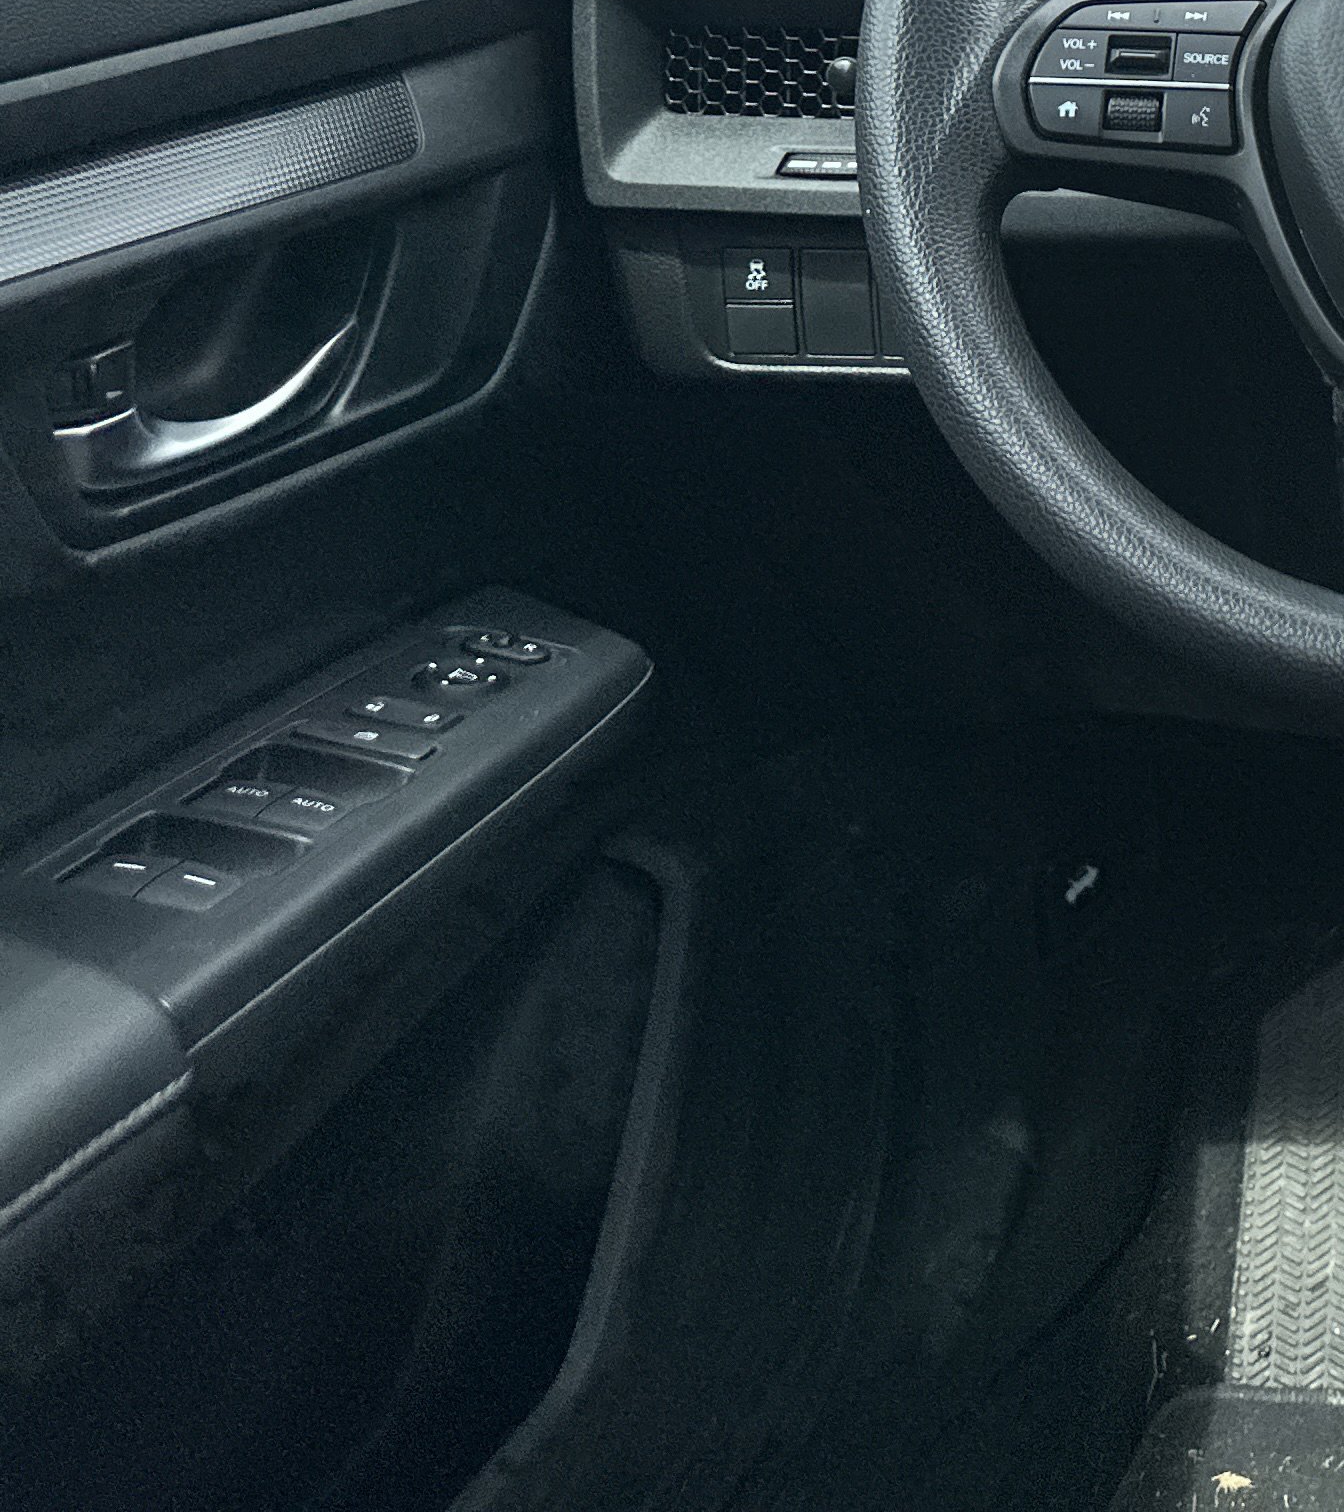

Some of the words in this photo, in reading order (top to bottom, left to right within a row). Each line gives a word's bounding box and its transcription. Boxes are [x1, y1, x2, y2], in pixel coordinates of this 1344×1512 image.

[1183, 52, 1229, 66] SOURCE
[745, 279, 769, 291] OFF
[226, 785, 269, 797] AUTO
[291, 797, 335, 812] AUTO
